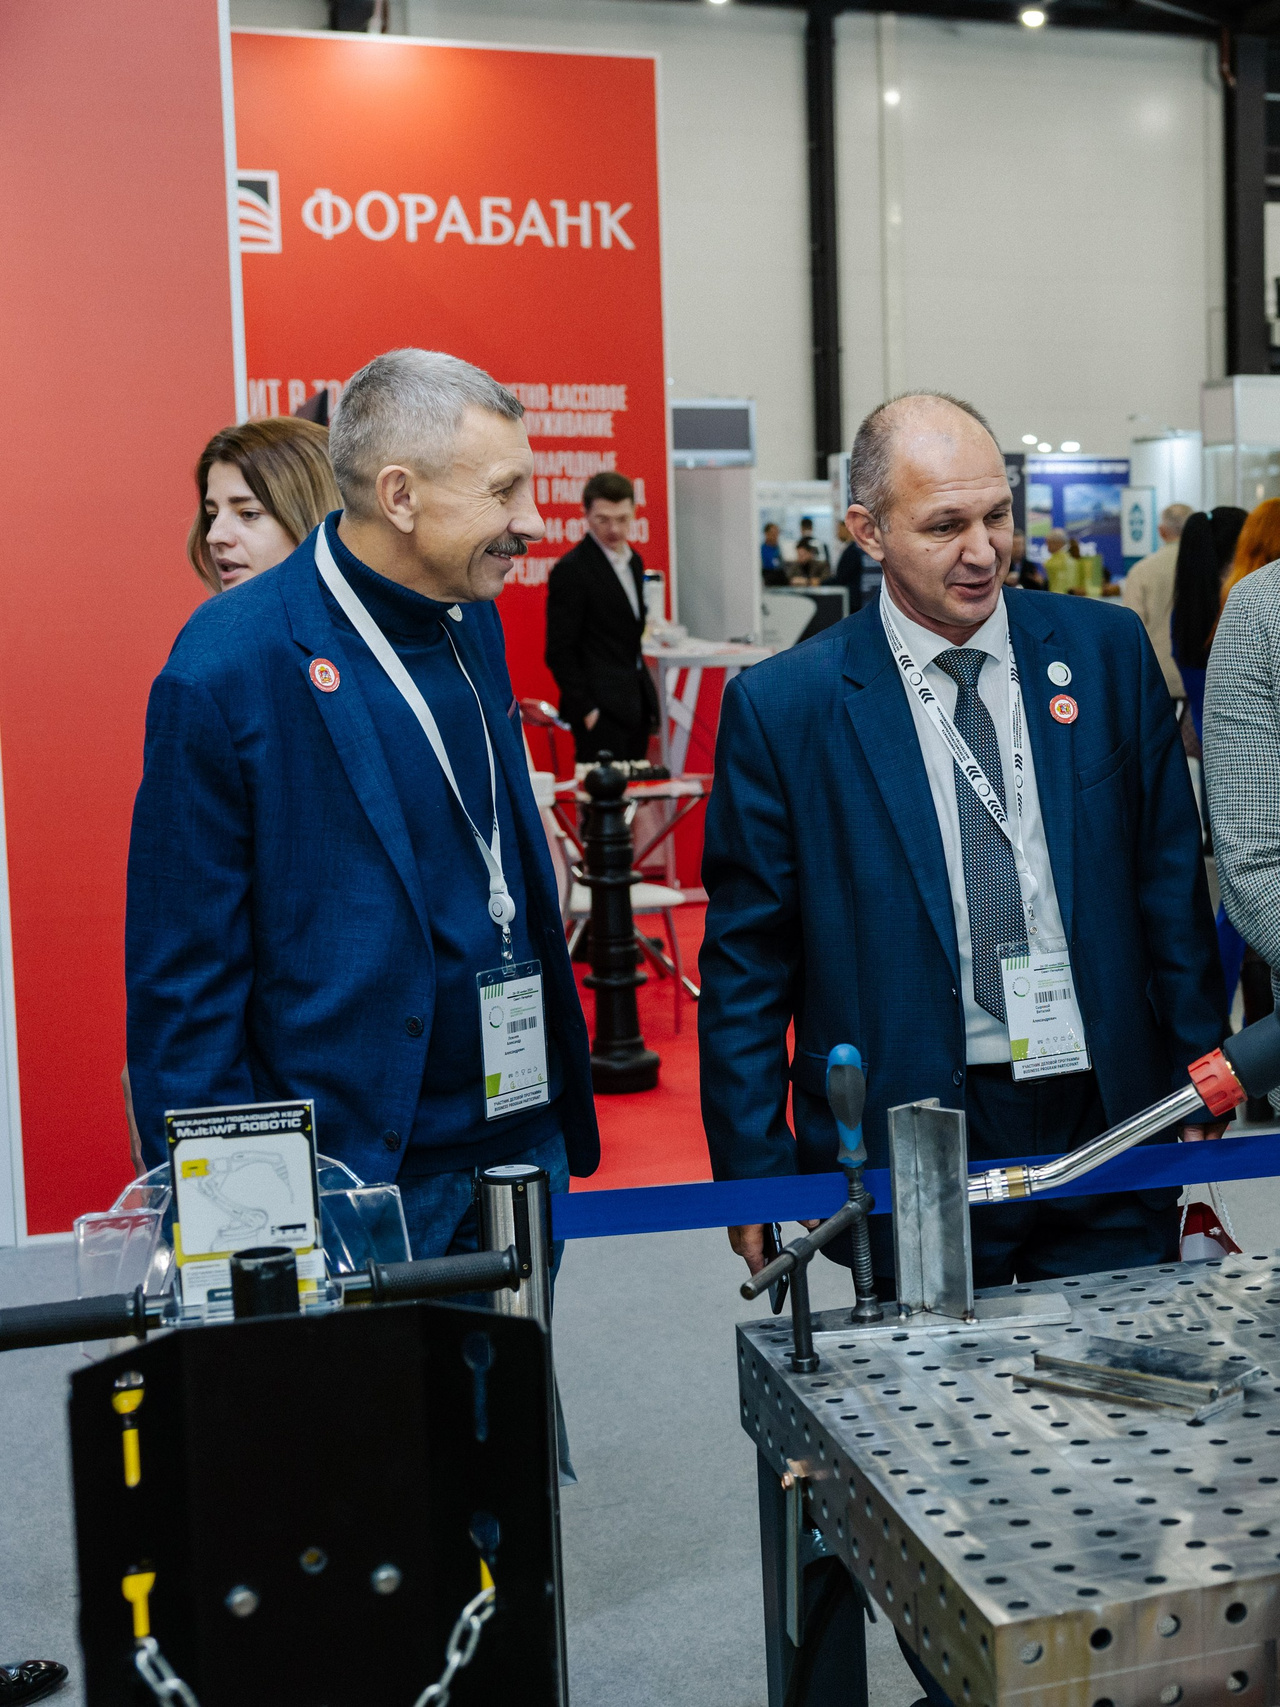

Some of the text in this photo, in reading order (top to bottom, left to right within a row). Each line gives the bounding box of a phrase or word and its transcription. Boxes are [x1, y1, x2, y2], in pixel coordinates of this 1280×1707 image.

[301, 188, 635, 250] ФОРАБАНК
[172, 1117, 225, 1127] МЕХАНИЗМ
[226, 1111, 280, 1123] ПОДАЮЩИЙ
[176, 1118, 302, 1138] MultiWF ROBOTIC
